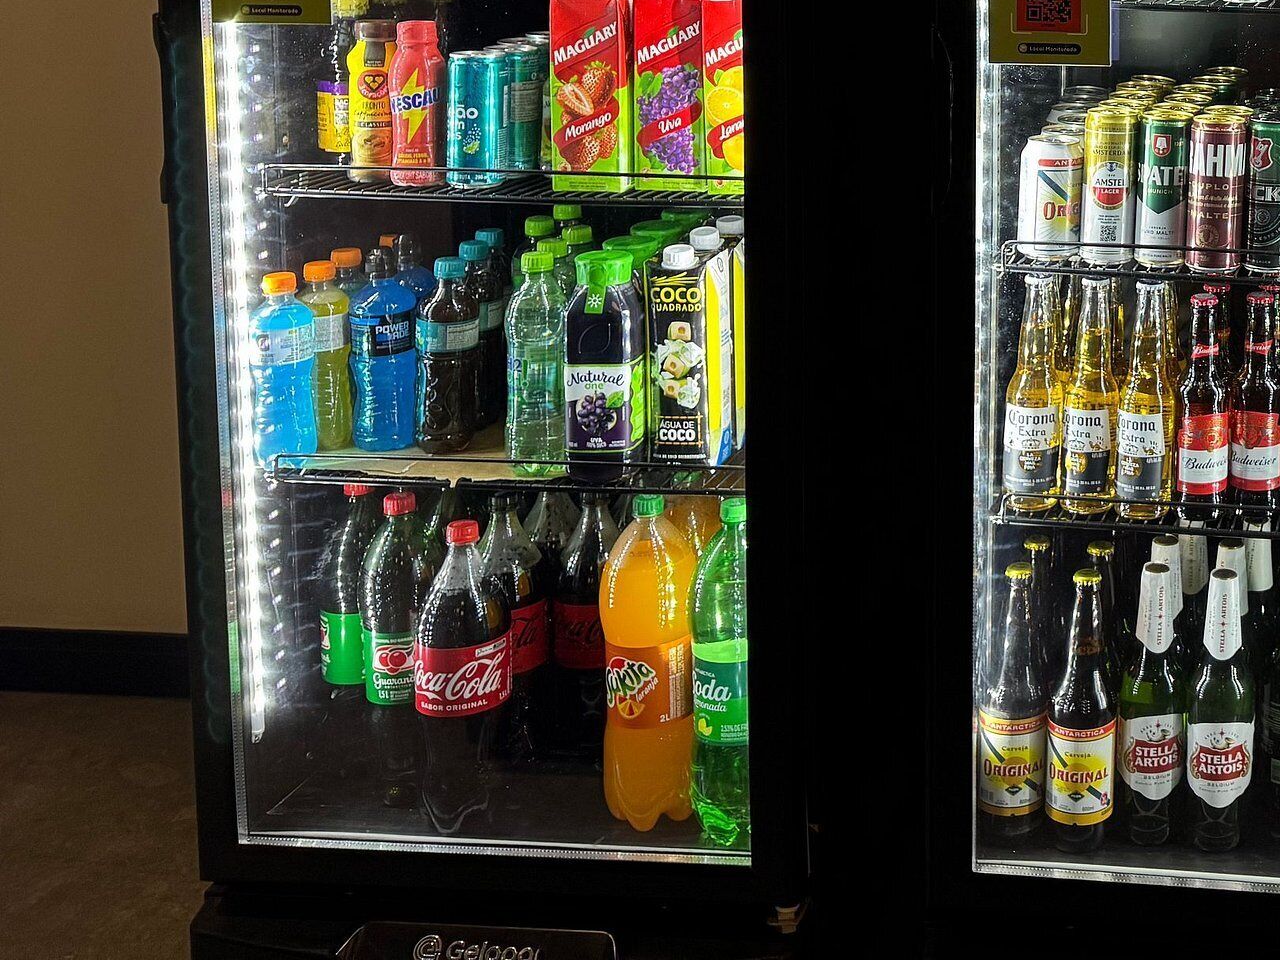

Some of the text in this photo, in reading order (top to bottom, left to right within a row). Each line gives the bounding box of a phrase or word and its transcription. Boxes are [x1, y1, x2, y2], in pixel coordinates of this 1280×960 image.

[553, 21, 618, 66] MAGUARY
[637, 20, 701, 65] MAGUARY
[565, 112, 612, 141] Morango
[658, 116, 682, 134] Uva
[651, 287, 702, 304] COCO
[375, 320, 410, 335] POWER
[566, 371, 625, 387] Natural
[660, 421, 695, 429] ÁGUA DE
[1008, 410, 1056, 426] Corona
[659, 429, 696, 442] COCO
[1018, 426, 1047, 437] Extra
[1066, 428, 1091, 439] Extra
[1121, 430, 1145, 444] Extra
[415, 649, 507, 702] Coca-Cola
[606, 658, 656, 708] Sukita
[635, 675, 659, 703] laranja
[421, 699, 489, 711] SABOR ORIGINAL
[660, 713, 670, 723] 2L
[1054, 727, 1105, 738] ANTARCTICA
[1001, 745, 1029, 753] Cerveja
[1064, 751, 1091, 760] Cerveja
[1135, 742, 1179, 757] STELLA
[1135, 753, 1179, 769] ARTOIS
[1199, 752, 1242, 765] STELLA
[984, 757, 1045, 777] ORIGINAL
[1050, 763, 1109, 784] ORIGINAL
[1199, 762, 1243, 775] ARTOIS
[1143, 773, 1171, 781] BELGIUM
[1206, 780, 1235, 788] BELGIUM
